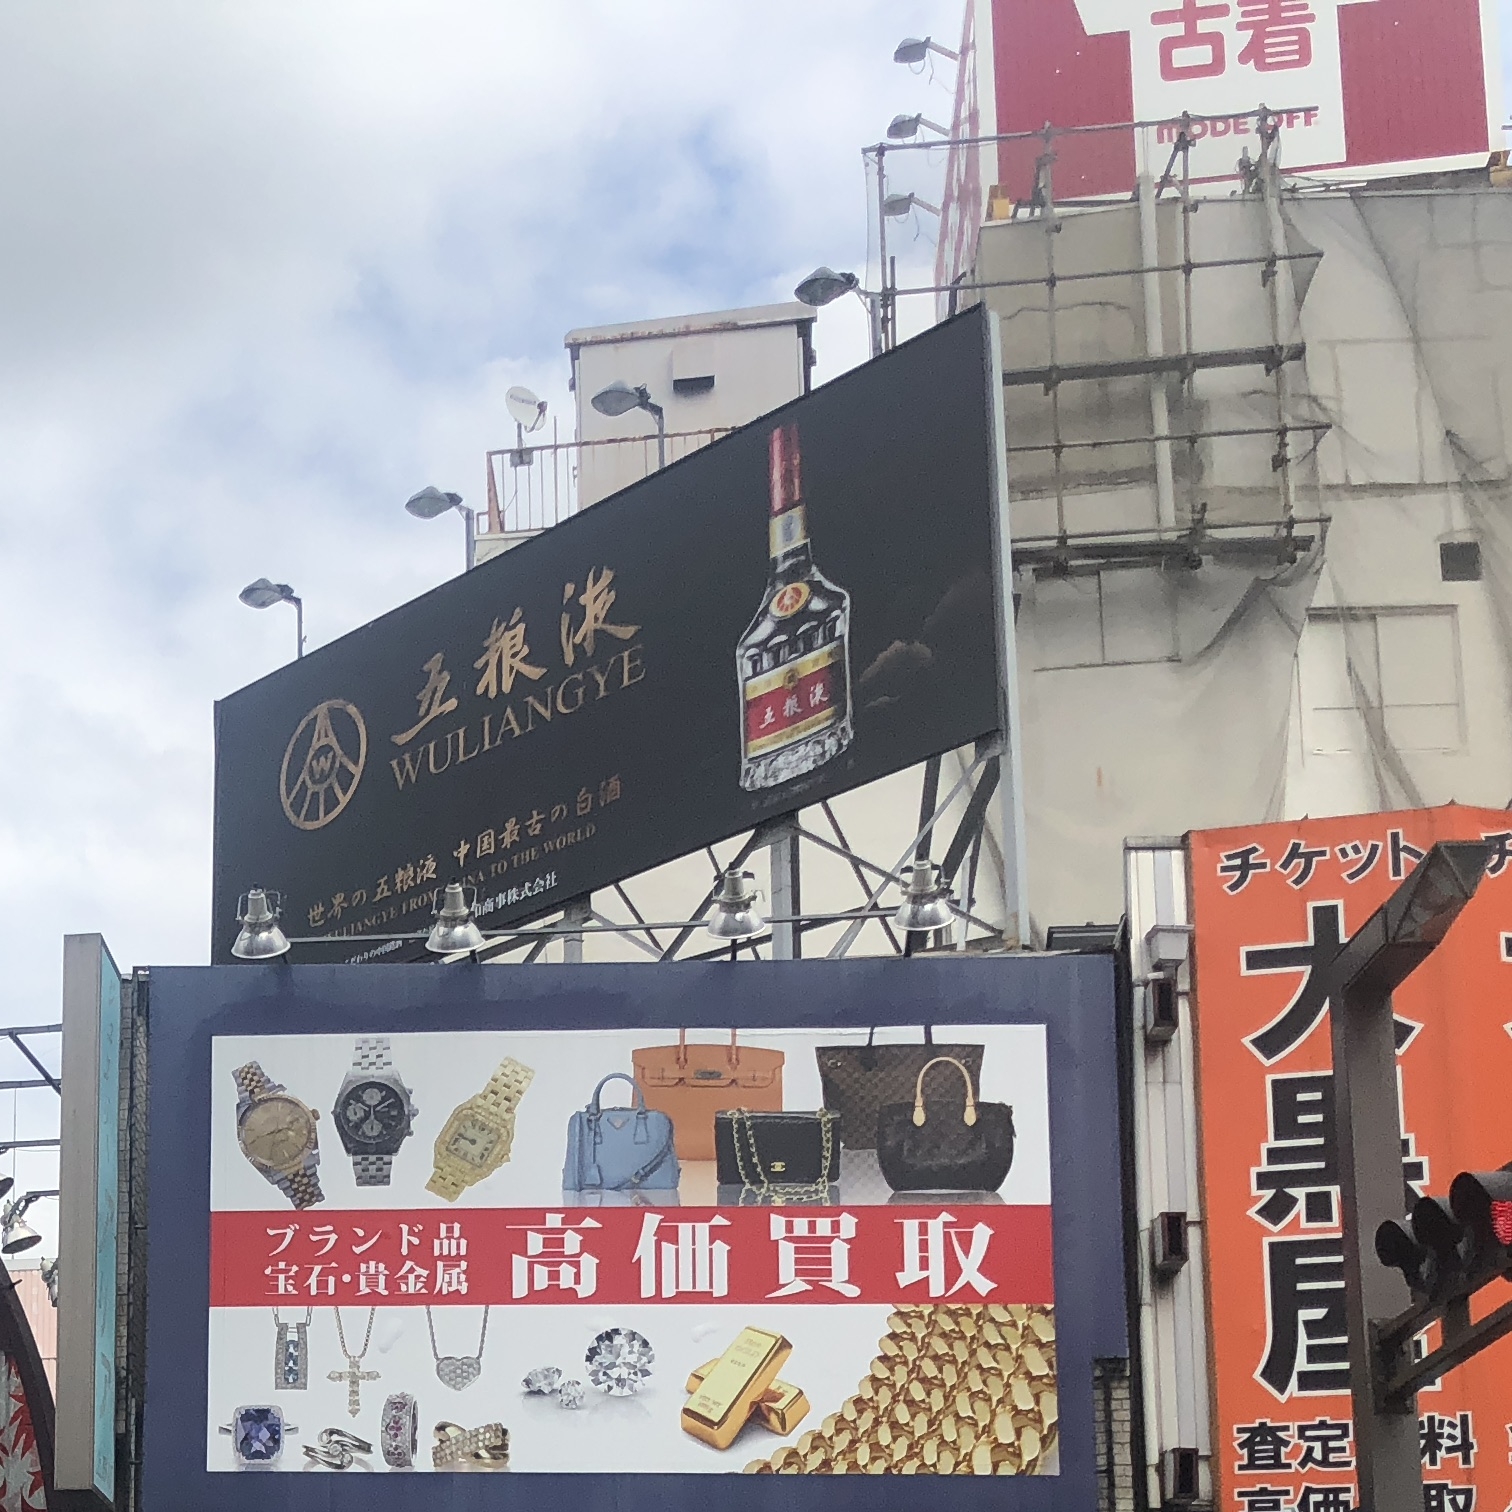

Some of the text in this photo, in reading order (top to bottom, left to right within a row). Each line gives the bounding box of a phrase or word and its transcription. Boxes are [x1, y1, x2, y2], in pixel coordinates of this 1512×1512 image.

[1150, 0, 1317, 82] 古着
[391, 565, 642, 746] 五粮液
[391, 645, 647, 791] WULIANGYE
[1217, 828, 1426, 895] チケット
[264, 1221, 470, 1256] ブランド品
[506, 1211, 1000, 1300] 高価買取
[263, 1260, 470, 1297] 宝石・貴金属
[1233, 1410, 1478, 1474] 査定料
